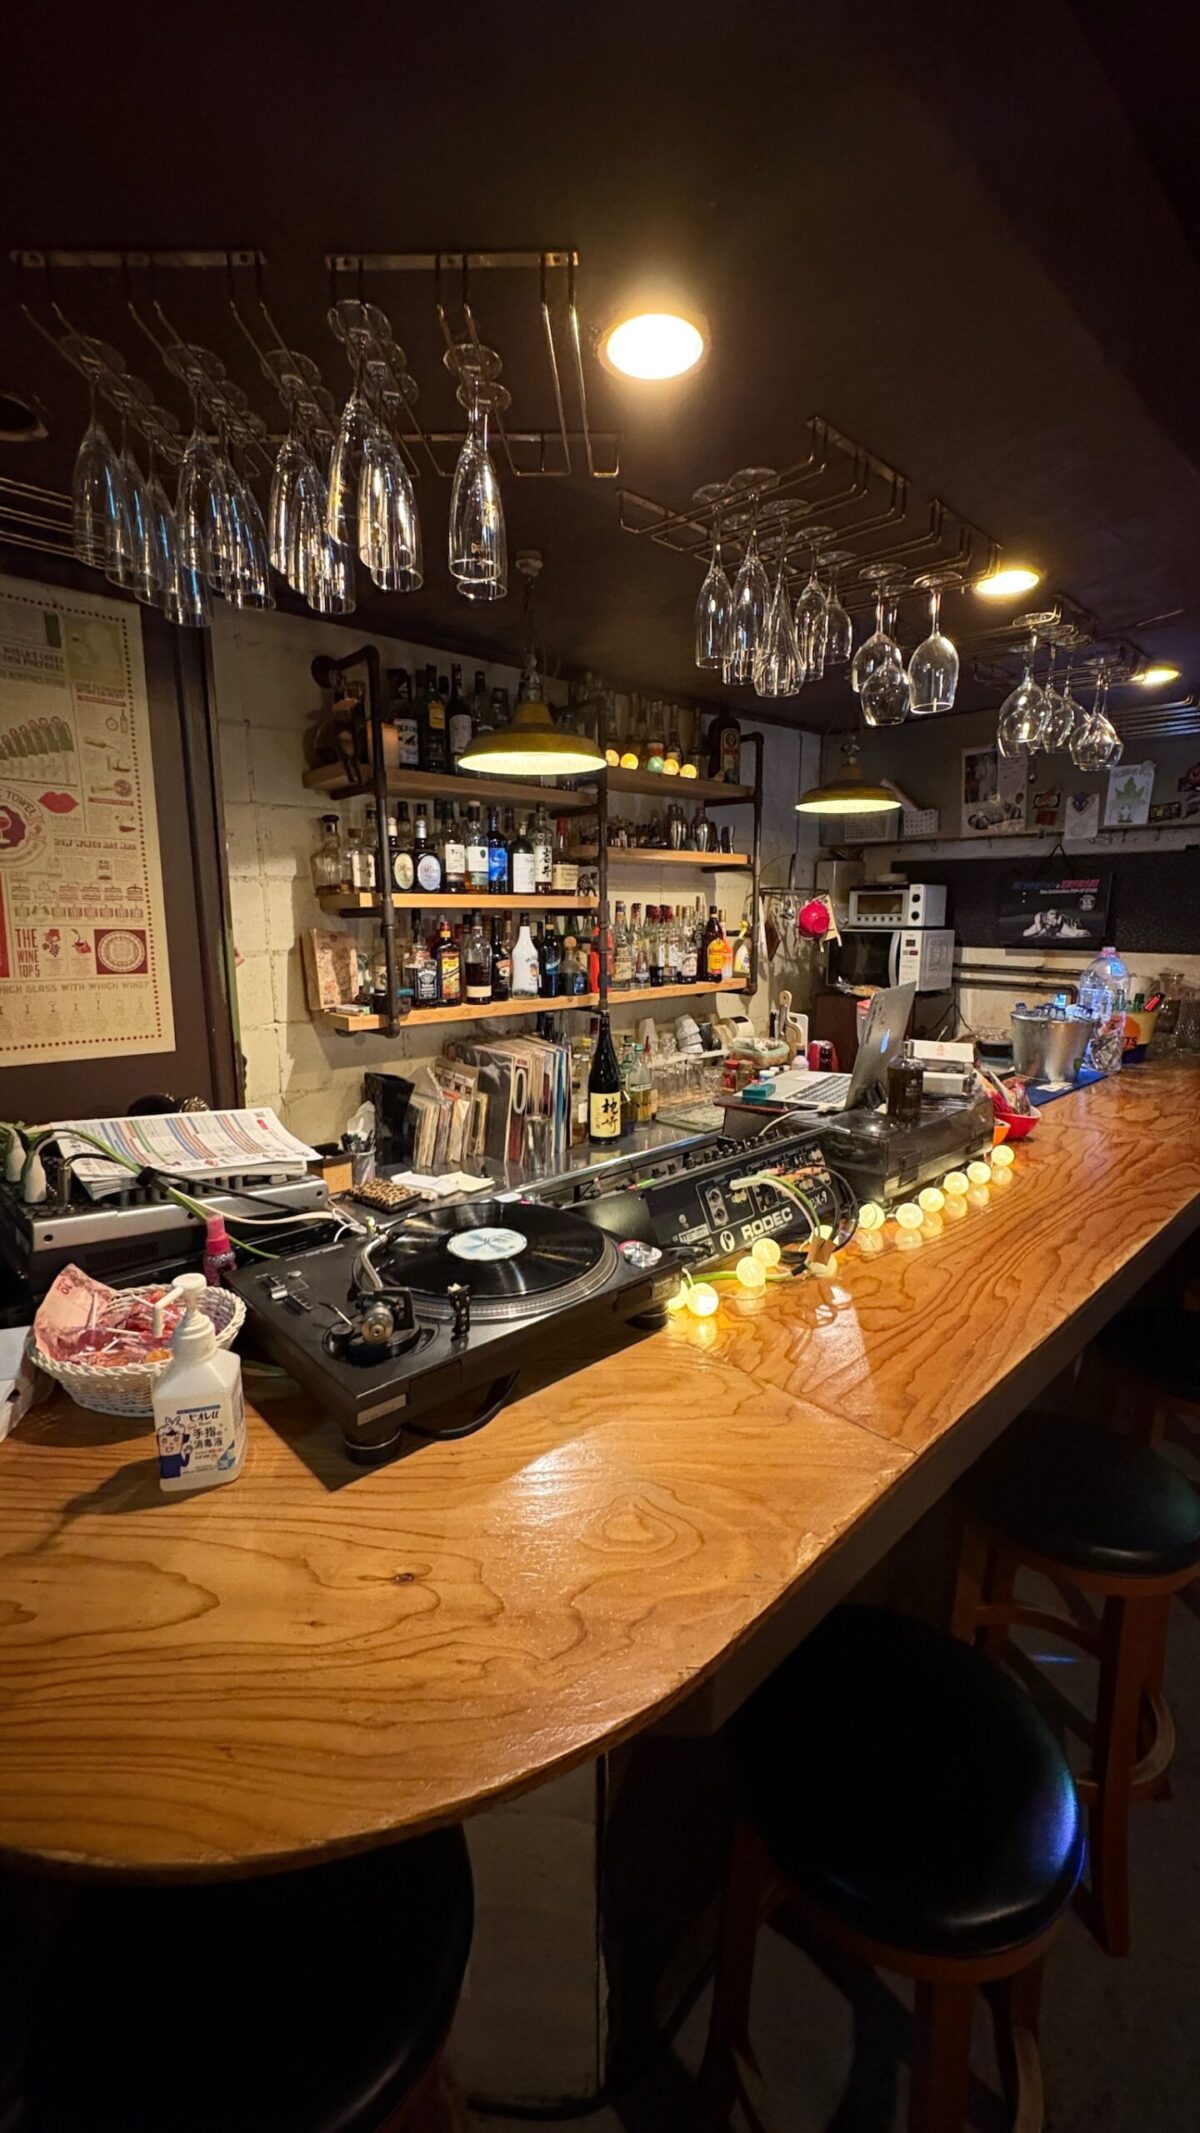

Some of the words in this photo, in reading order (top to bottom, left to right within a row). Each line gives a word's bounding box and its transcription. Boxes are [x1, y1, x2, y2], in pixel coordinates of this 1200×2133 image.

[6, 789, 37, 817] TOWEL
[15, 928, 39, 949] THE
[16, 950, 40, 963] WINE
[18, 964, 35, 978] TOP
[35, 963, 41, 978] 5
[26, 983, 58, 994] GLASS
[61, 982, 85, 993] WITH
[88, 982, 119, 992] WHICH
[740, 1207, 793, 1241] RODEC
[194, 1437, 223, 1450] 消毒液
